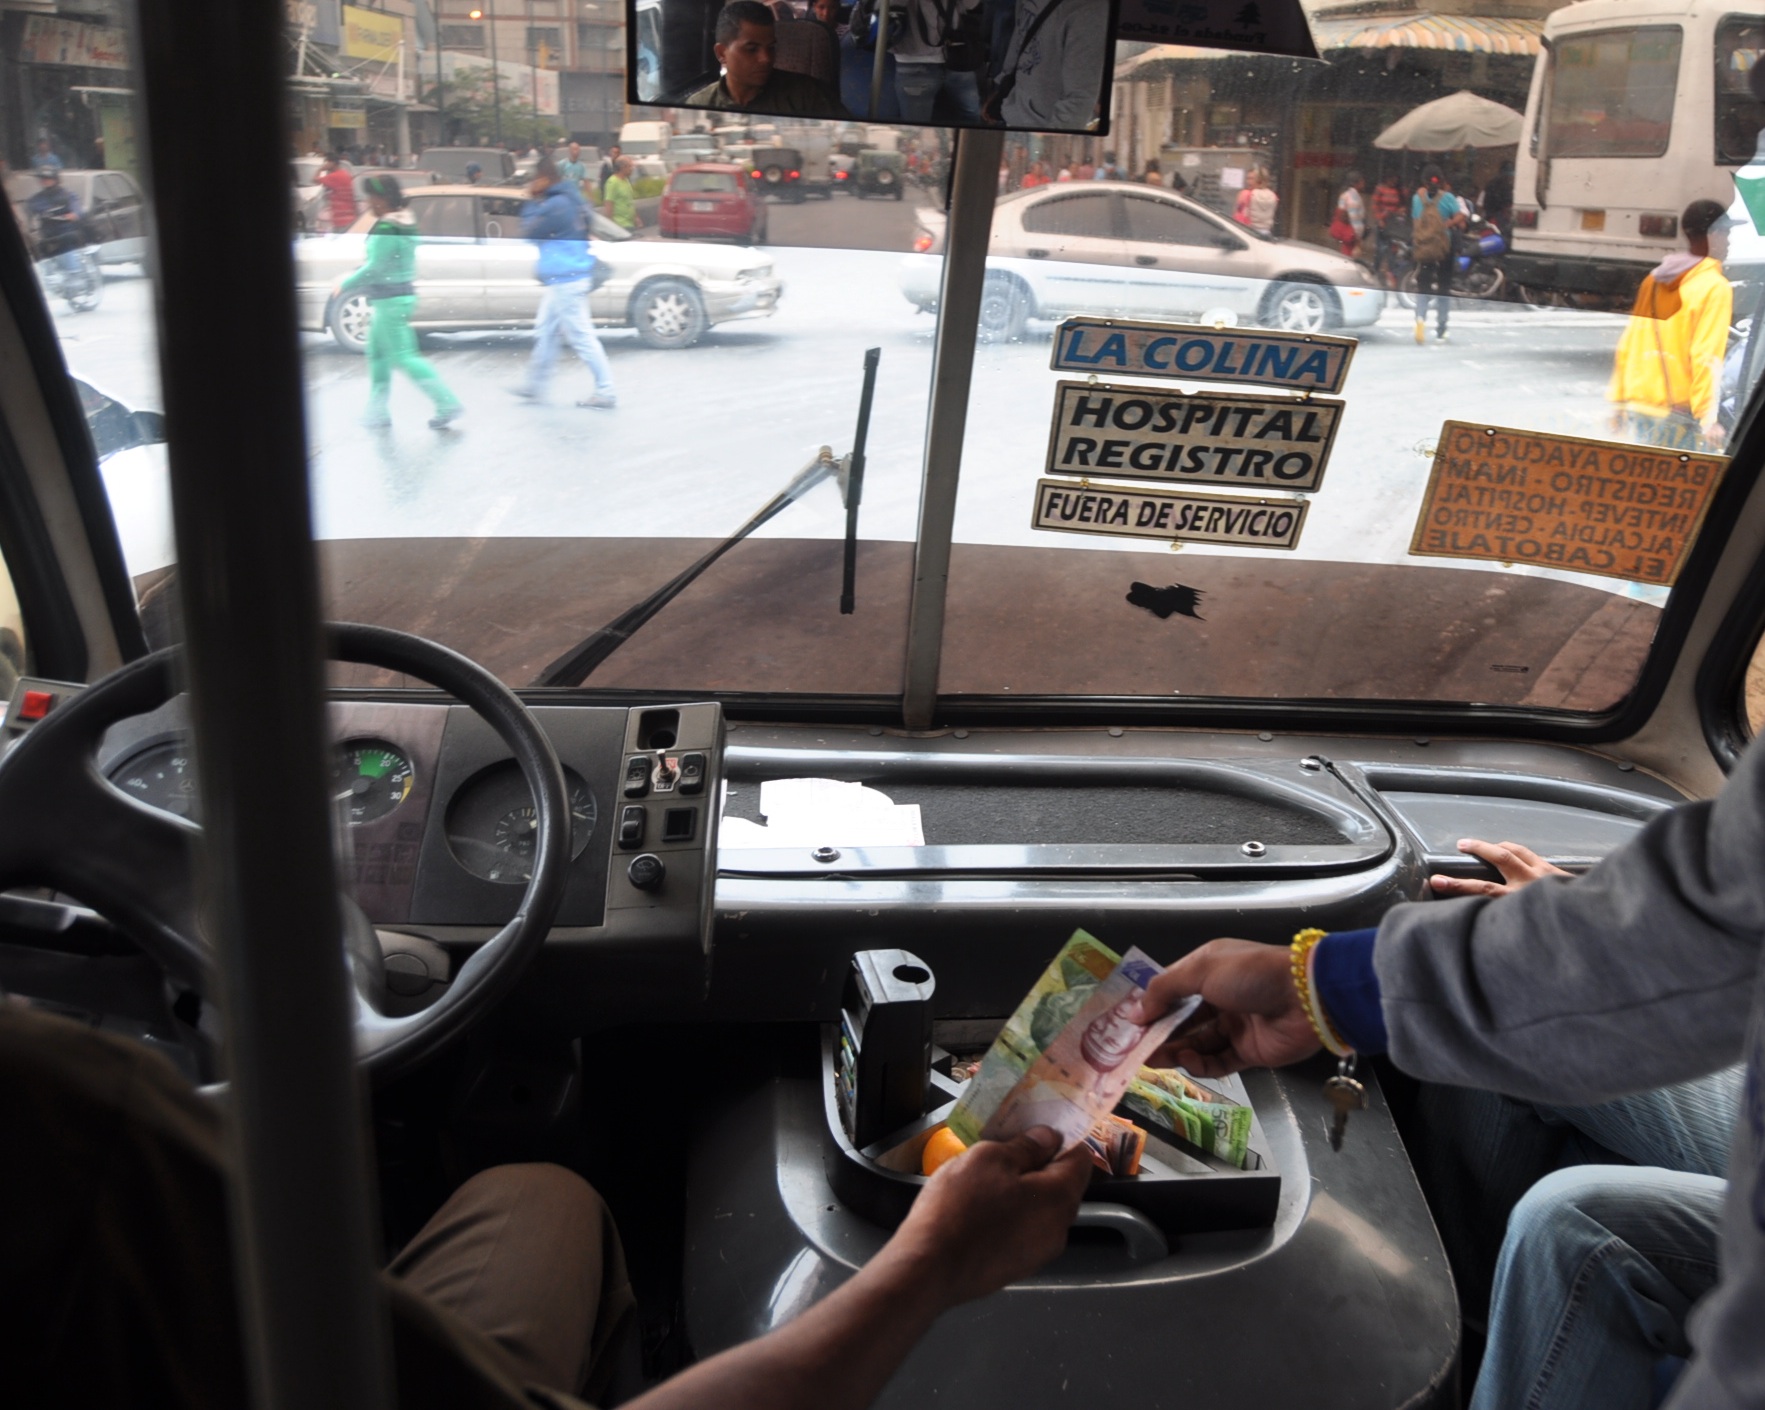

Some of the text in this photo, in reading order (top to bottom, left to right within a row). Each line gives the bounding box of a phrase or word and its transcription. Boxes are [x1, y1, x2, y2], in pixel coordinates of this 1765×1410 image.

[1064, 330, 1329, 383] LA COLINA
[1070, 395, 1322, 443] HOSPITAL
[1061, 437, 1313, 480] REGISTRO
[1044, 492, 1294, 538] FUERA DE SERVICIO
[390, 792, 401, 800] 30
[391, 774, 402, 782] 25
[1212, 1107, 1229, 1139] 50
